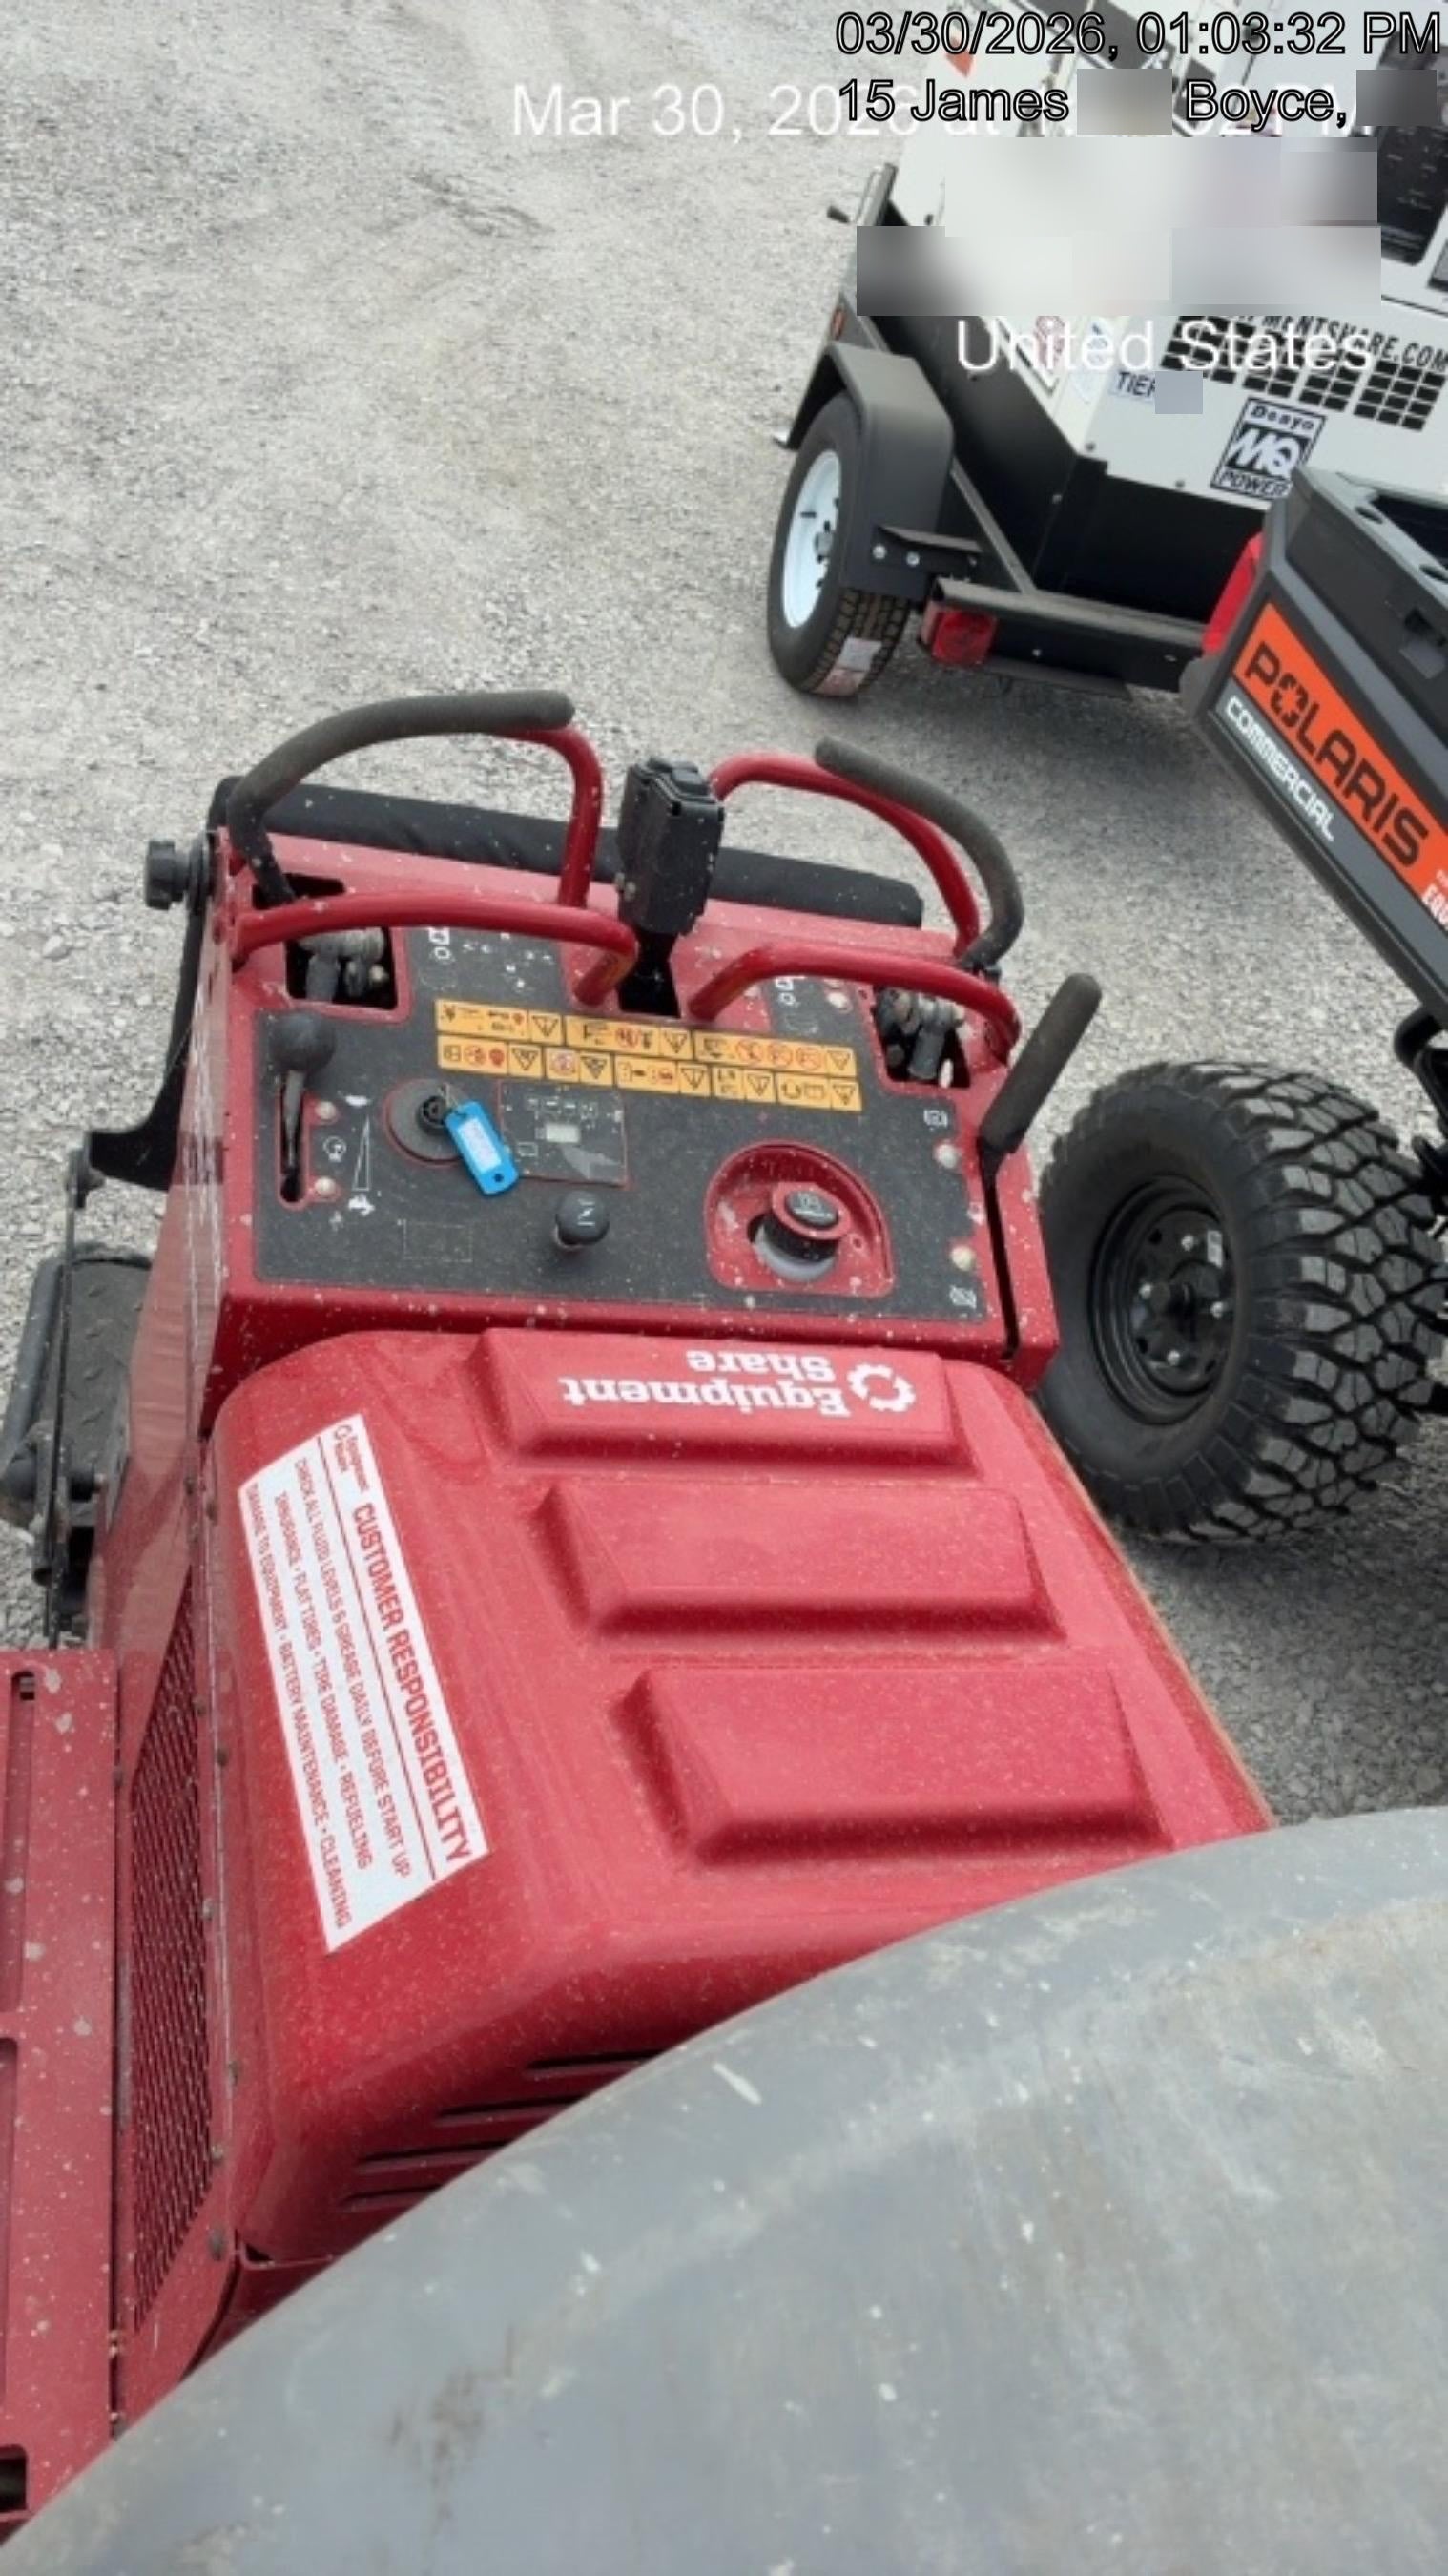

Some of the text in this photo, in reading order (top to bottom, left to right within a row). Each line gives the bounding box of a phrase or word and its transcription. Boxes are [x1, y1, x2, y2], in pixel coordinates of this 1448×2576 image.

[1226, 696, 1335, 842] COMMERCIAL
[1245, 641, 1429, 867] POLARIS
[562, 1377, 850, 1417] Equipment
[686, 1349, 836, 1381] Share
[352, 1503, 471, 1861] CUSTOMER RESPONSIBILITY
[338, 1773, 372, 1869] REFUELING
[349, 1682, 372, 1726] DAILY
[361, 1730, 388, 1791] BEFORE
[377, 1795, 403, 1849] START
[390, 1853, 410, 1880] UP
[319, 1836, 351, 1928] CLEANING
